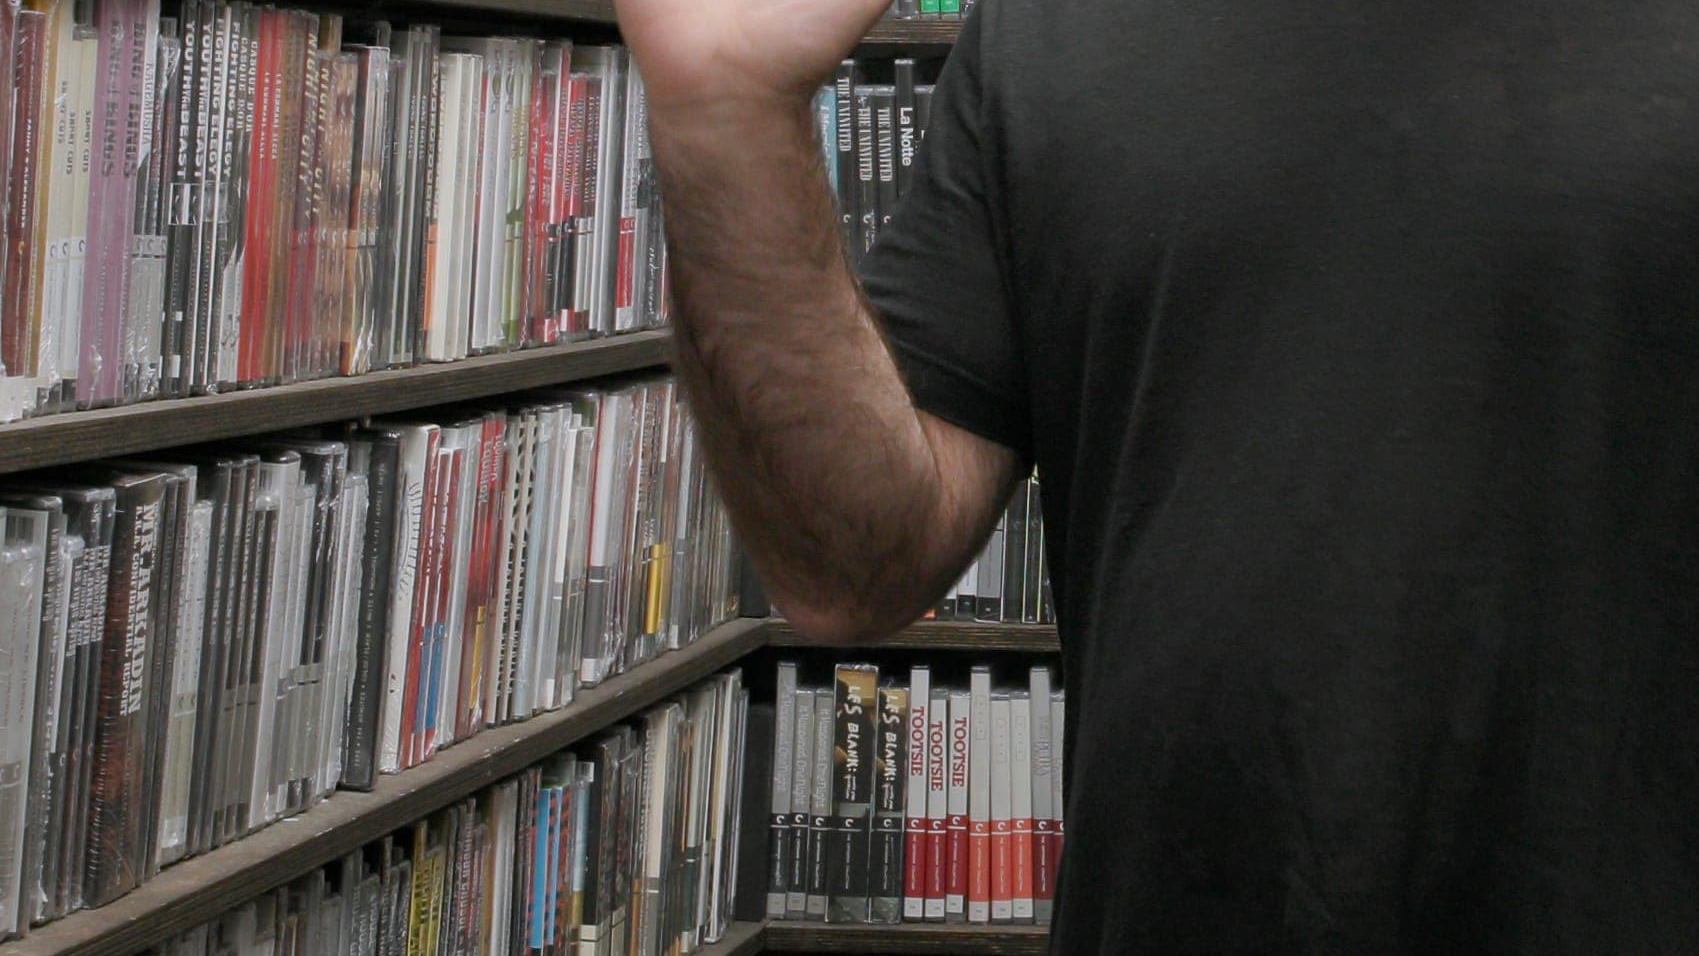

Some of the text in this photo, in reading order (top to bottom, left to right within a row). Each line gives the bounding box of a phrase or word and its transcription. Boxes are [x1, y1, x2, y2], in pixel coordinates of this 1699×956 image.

[176, 21, 196, 180] YOUTH BEAST
[207, 19, 224, 175] FIGHTING ELEGY
[857, 107, 872, 181] THE UNINVITED
[876, 108, 892, 182] THE UNINVITED
[900, 108, 913, 167] La Notte
[125, 553, 140, 655] CONFIDENTIAL
[128, 567, 153, 716] ARKADIN
[881, 695, 899, 724] LES
[910, 707, 925, 777] TOOTSIE
[930, 721, 944, 792] TOOTSIE
[951, 717, 967, 788] TOOTSIE
